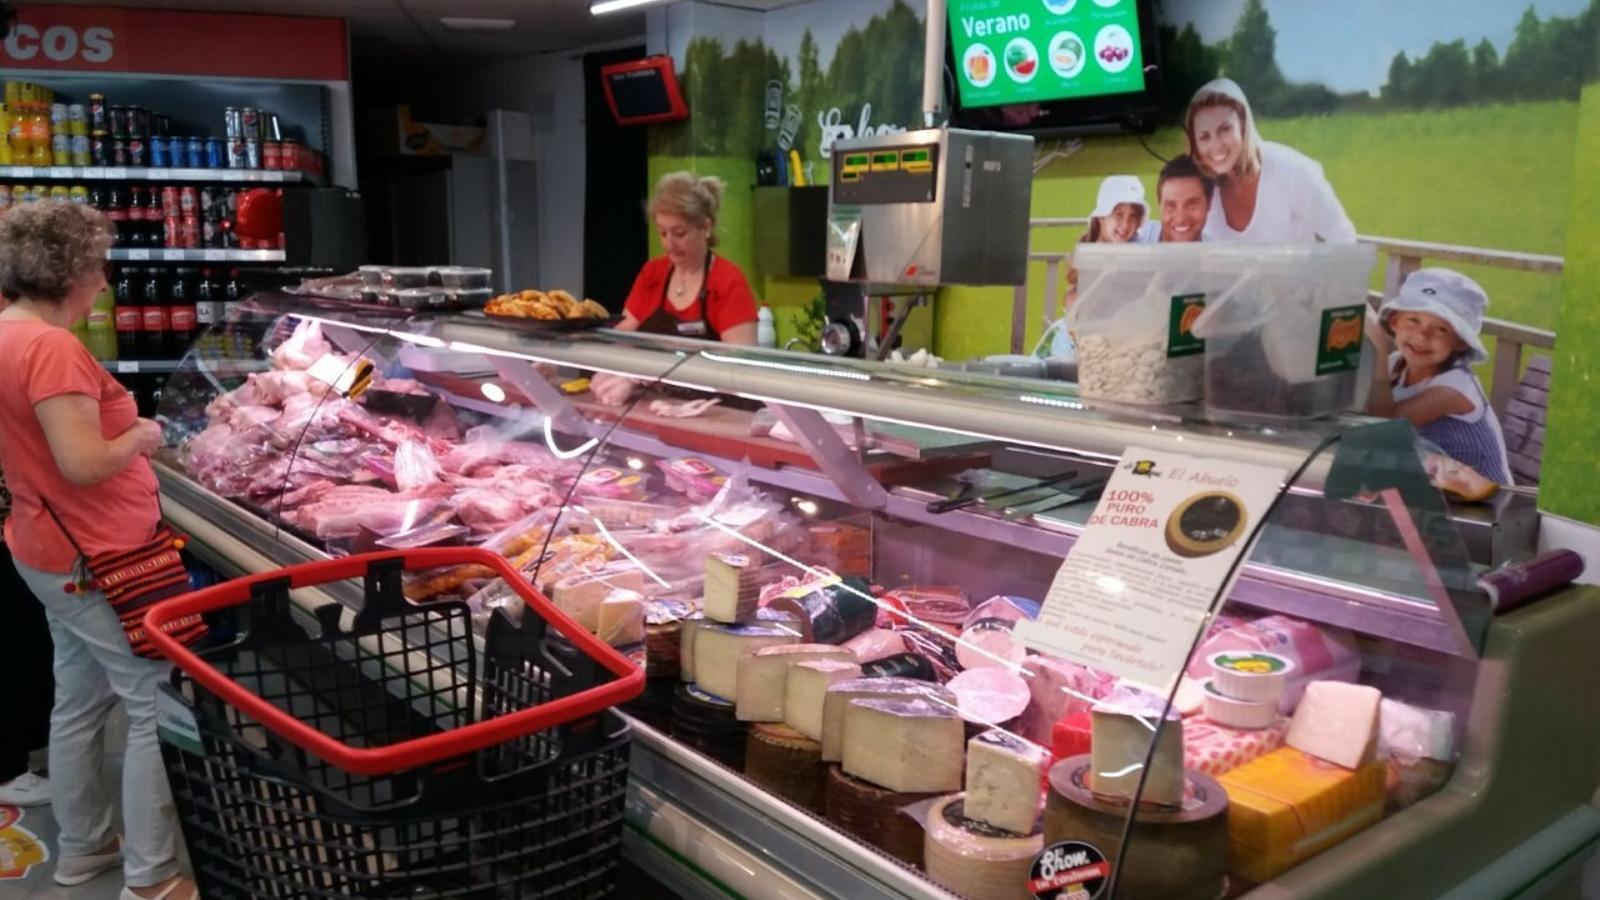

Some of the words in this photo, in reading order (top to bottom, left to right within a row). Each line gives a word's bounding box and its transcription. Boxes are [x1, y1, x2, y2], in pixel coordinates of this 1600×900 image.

[961, 13, 1030, 38] Verano
[1168, 468, 1187, 480] El
[1108, 489, 1155, 504] 100%
[1106, 503, 1147, 515] PURO
[1089, 515, 1106, 525] DE
[1110, 515, 1159, 528] CABRA
[1040, 847, 1087, 881] Show
